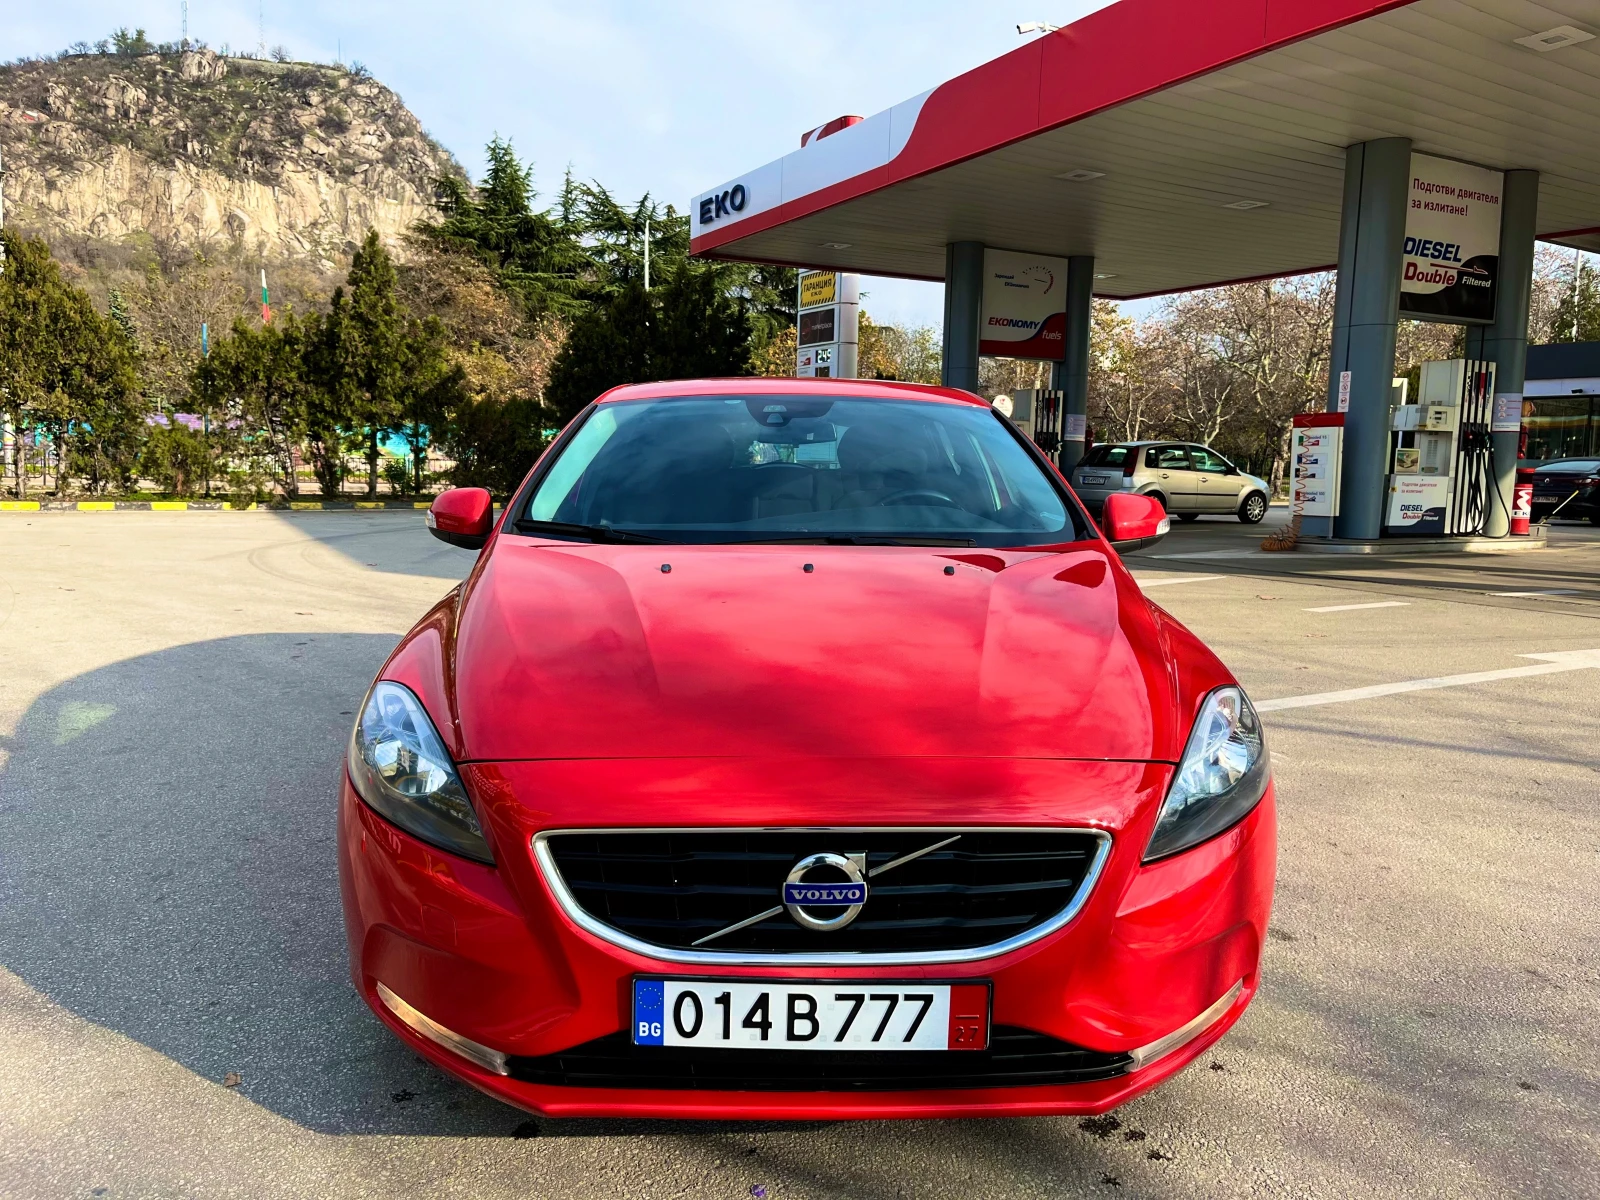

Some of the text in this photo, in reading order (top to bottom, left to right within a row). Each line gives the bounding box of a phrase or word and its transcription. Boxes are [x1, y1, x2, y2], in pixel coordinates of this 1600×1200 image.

[1412, 178, 1499, 205] Подготви двигателя
[699, 184, 746, 224] EKO
[1411, 199, 1468, 216] за излитане!
[1404, 236, 1462, 263] DIESEL
[1404, 261, 1456, 286] Double
[1461, 275, 1492, 288] Filtered
[803, 278, 832, 293] ГАРАНЦИЯ
[988, 316, 1040, 330] EKONOMY
[1042, 329, 1062, 340] fuels
[1400, 504, 1424, 512] DIESEL
[790, 889, 861, 900] VOLVO
[638, 989, 934, 1043] BG 014B777
[954, 1025, 980, 1042] 27
